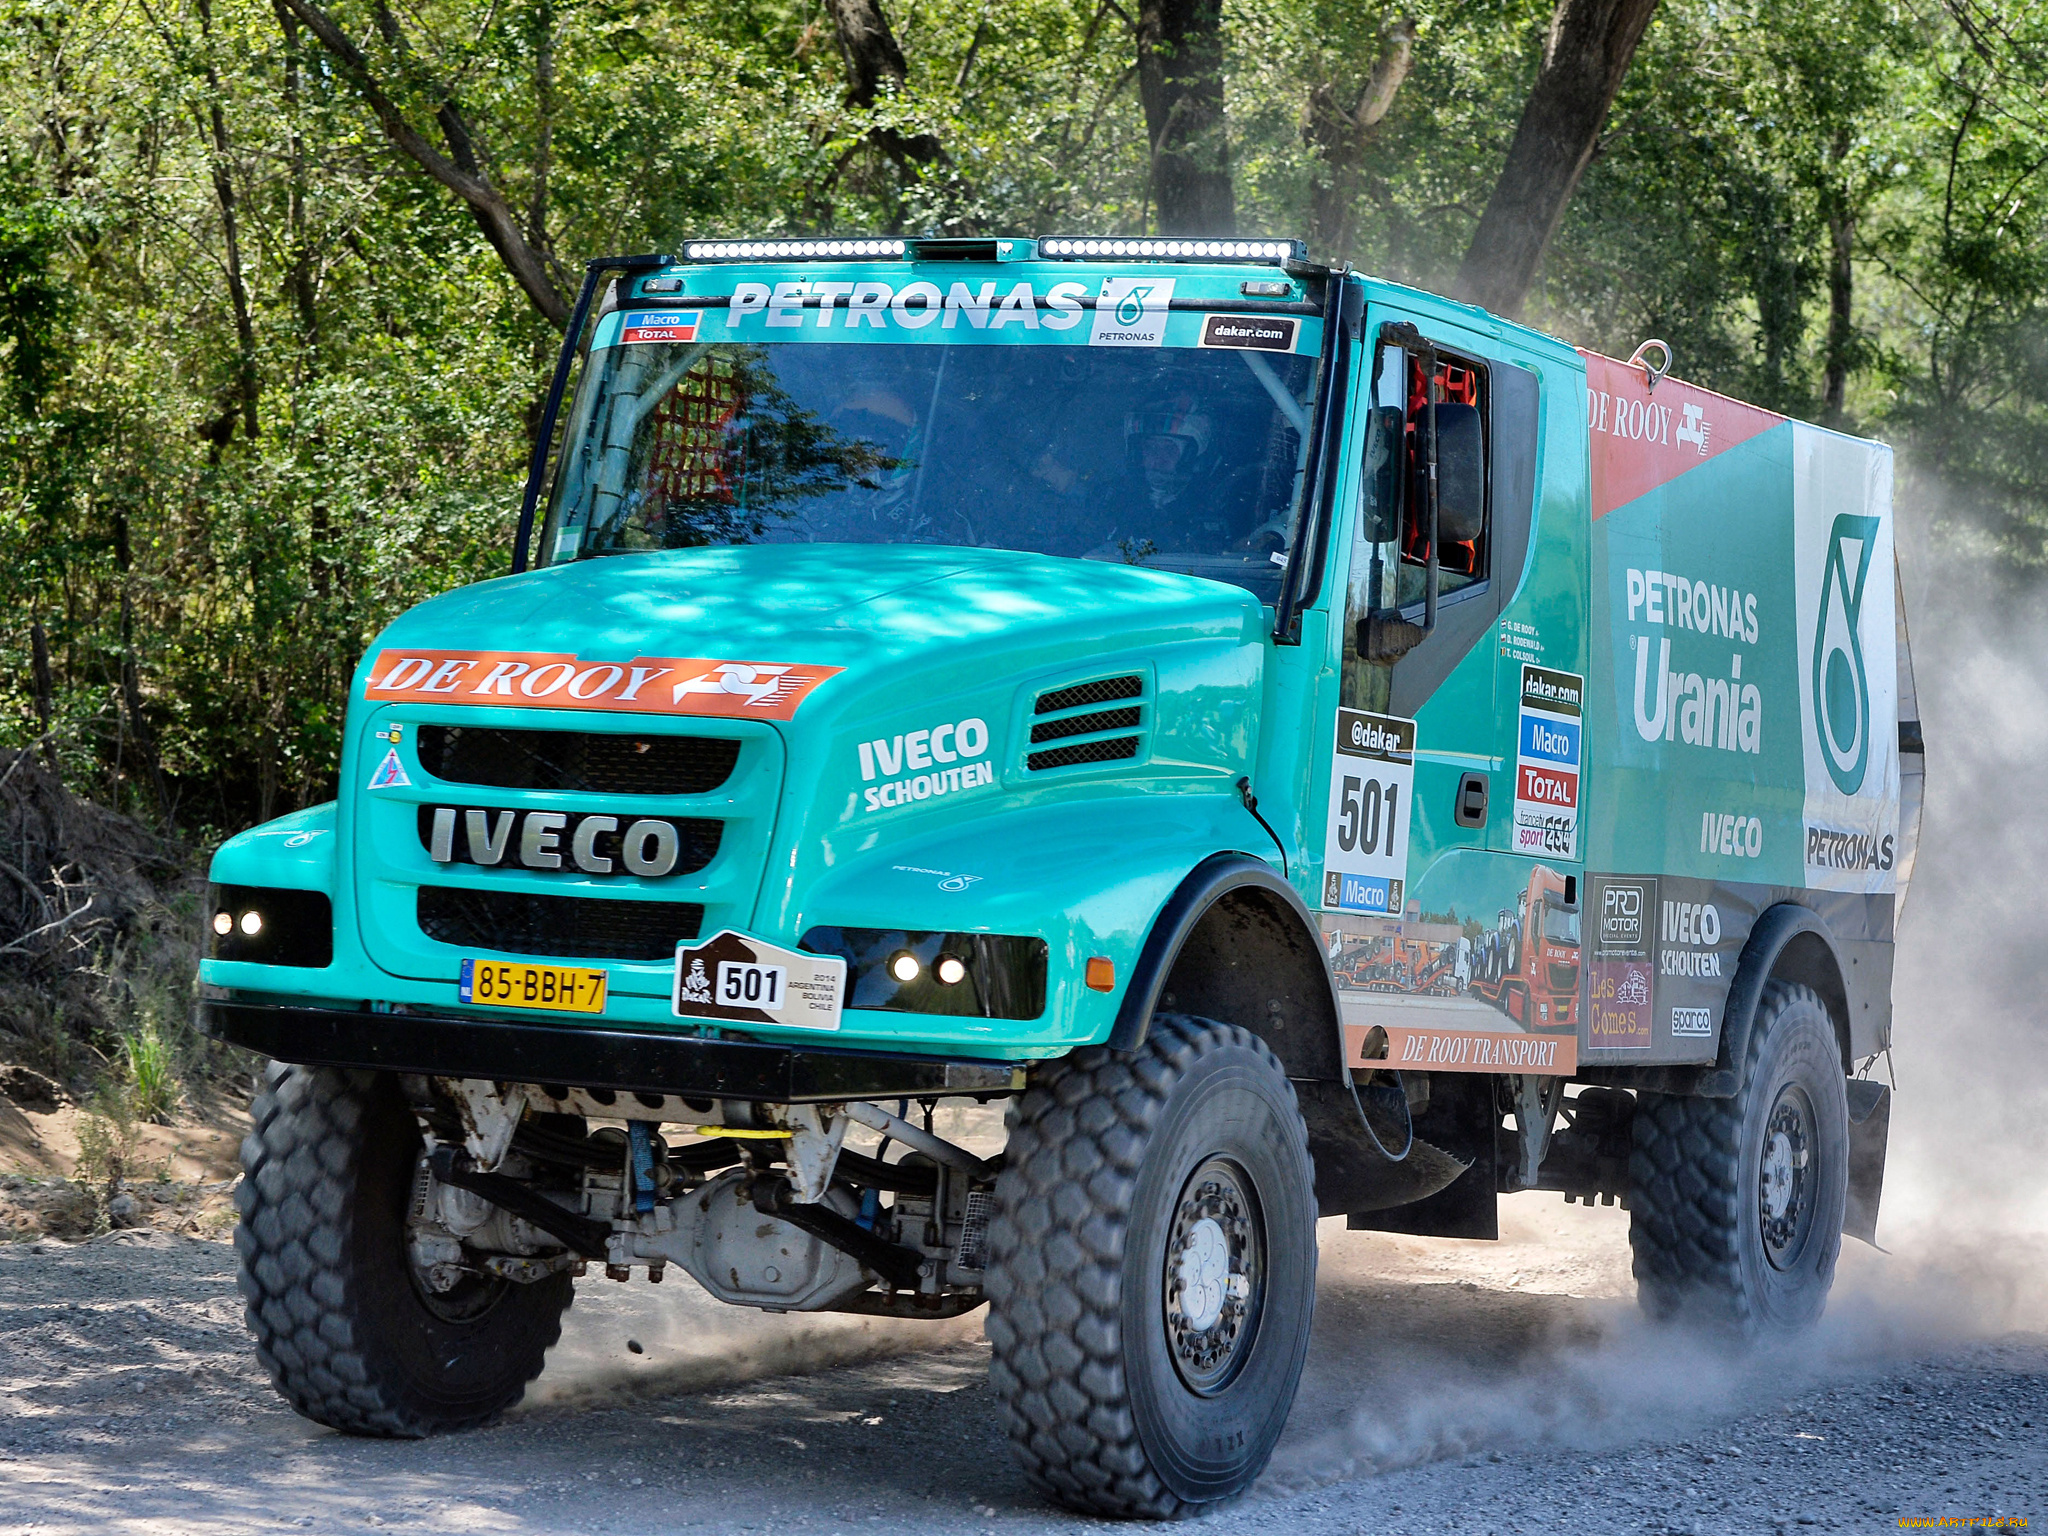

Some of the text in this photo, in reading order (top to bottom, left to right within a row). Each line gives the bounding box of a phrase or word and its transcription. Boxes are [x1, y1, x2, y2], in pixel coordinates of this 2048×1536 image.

[642, 315, 680, 325] Macro
[726, 281, 1087, 330] PETRONAS
[1099, 332, 1155, 341] PETRONAS
[1215, 325, 1284, 340] dakar.com
[1588, 388, 1673, 446] DE ROOY
[1627, 568, 1759, 645] PETRONAS
[373, 658, 674, 701] DE ROOY
[1526, 674, 1579, 706] dakar.com
[1634, 635, 1762, 754] Urania
[858, 717, 989, 781] IVECO
[1351, 720, 1401, 752] @dakar
[1532, 724, 1570, 756] Macro
[864, 760, 994, 813] SCHOUTEN
[1525, 769, 1571, 803] TOTAL
[1338, 775, 1398, 857] 501
[430, 808, 680, 877] IVECO
[1520, 829, 1543, 848] sport
[1700, 812, 1762, 858] IVECO
[1807, 827, 1894, 871] PETRONAS
[892, 865, 951, 876] PETRONAS
[1345, 880, 1384, 906] Macro
[1604, 890, 1640, 915] PRO
[1603, 918, 1639, 931] MOTOR
[1662, 900, 1721, 945] IVECO
[813, 974, 836, 982] 2014
[1661, 949, 1721, 977] SCHOUTEN
[479, 966, 605, 1006] 85-BBH-7
[724, 967, 778, 1003] 501
[788, 981, 835, 992] ARGENTINA
[802, 992, 834, 1001] BOLIVIA
[1591, 971, 1615, 998] Les
[809, 1002, 833, 1011] CHILE
[1673, 1011, 1710, 1034] sparco
[1401, 1034, 1558, 1067] DE ROOY TRANSPORT
